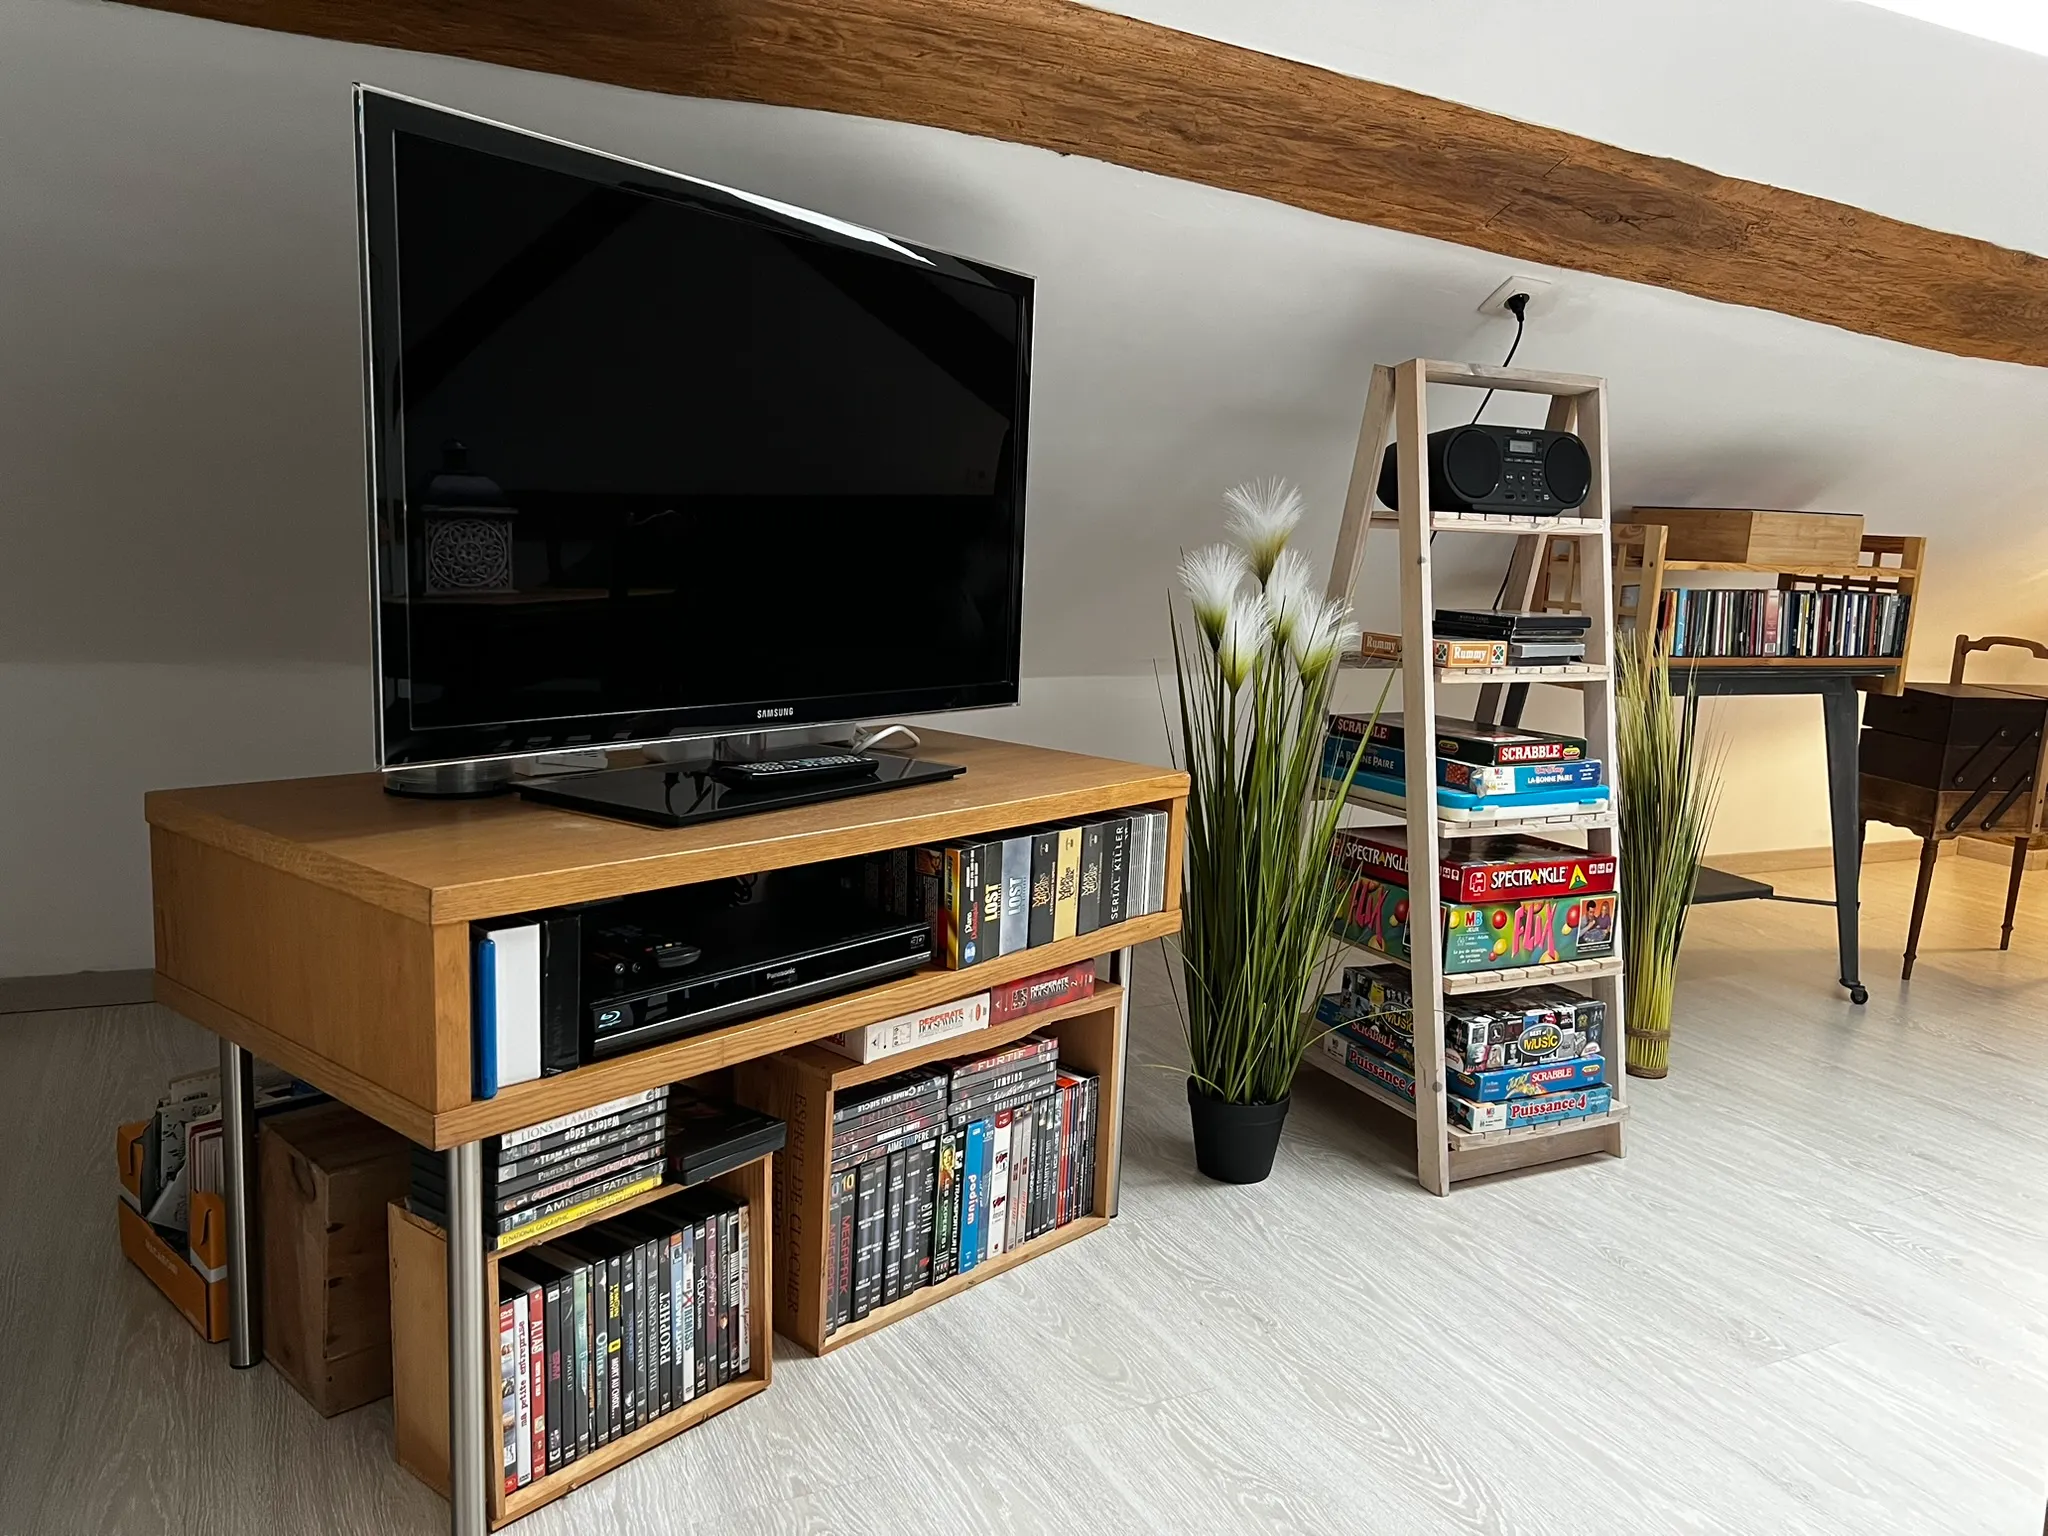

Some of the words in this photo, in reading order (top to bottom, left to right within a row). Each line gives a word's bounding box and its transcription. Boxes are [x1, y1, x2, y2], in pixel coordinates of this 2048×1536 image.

[1366, 636, 1397, 652] Rummy
[1454, 646, 1487, 661] Rummy
[757, 707, 794, 718] SAMSUNG
[1373, 755, 1395, 770] PAIRE
[1502, 745, 1560, 761] SCRABBLE
[1494, 768, 1503, 776] MB
[1536, 775, 1557, 784] BONNE
[1557, 774, 1573, 783] PAIRE
[1115, 826, 1124, 870] KILLER
[1491, 866, 1566, 888] SPECTRANGLE
[984, 884, 1000, 922] LOST
[1008, 877, 1024, 916] LOST
[1110, 875, 1121, 920] SERIAL
[1464, 910, 1483, 927] MB
[766, 967, 796, 980] Panasonic
[1030, 976, 1069, 992] DESPERATE
[1031, 983, 1069, 999] HOUSEWIVES
[918, 1008, 964, 1026] DESPERATE
[918, 1016, 964, 1034] HOUSEWIVES
[1524, 1035, 1558, 1051] MUSIC
[1529, 1029, 1542, 1037] BEST
[977, 1049, 1025, 1071] FURTIF
[1349, 1048, 1407, 1090] Puissance
[1531, 1067, 1573, 1083] SCRABBLE
[881, 1095, 892, 1104] DU
[893, 1085, 917, 1099] CRIME
[917, 1085, 925, 1093] LE
[1511, 1099, 1575, 1118] Puissance
[1576, 1093, 1587, 1109] 4
[521, 1124, 553, 1140] LIONS
[564, 1109, 599, 1126] LAMBS
[565, 1126, 586, 1142] Edge
[540, 1150, 563, 1165] TEAM
[563, 1136, 600, 1155] AMERICA
[791, 1175, 805, 1206] DE
[840, 1173, 855, 1190] 10
[545, 1187, 602, 1215] AMNESIE
[602, 1172, 643, 1193] FATALE
[967, 1174, 978, 1225] podium
[951, 1182, 960, 1247] TRANSPORTEUR
[508, 1227, 535, 1242] NATIONAL
[535, 1213, 569, 1234] GEOGRAPHIC
[787, 1213, 803, 1313] CLOCHER
[840, 1215, 851, 1295] MEGAPACK
[730, 1252, 738, 1281] DOUBLE
[740, 1264, 748, 1280] The
[697, 1274, 705, 1299] YEUX
[730, 1281, 738, 1307] VISION
[648, 1285, 657, 1328] CAPONE
[674, 1280, 682, 1327] MASTER
[531, 1320, 544, 1354] ALIAS
[660, 1292, 671, 1366] PROPHET
[518, 1321, 526, 1376] entreprise
[674, 1329, 682, 1366] NIGHT
[611, 1357, 620, 1378] MORT
[649, 1332, 657, 1391] DILLINGER
[520, 1379, 528, 1410] petite
[611, 1378, 619, 1389] AU
[520, 1412, 528, 1428] ma
